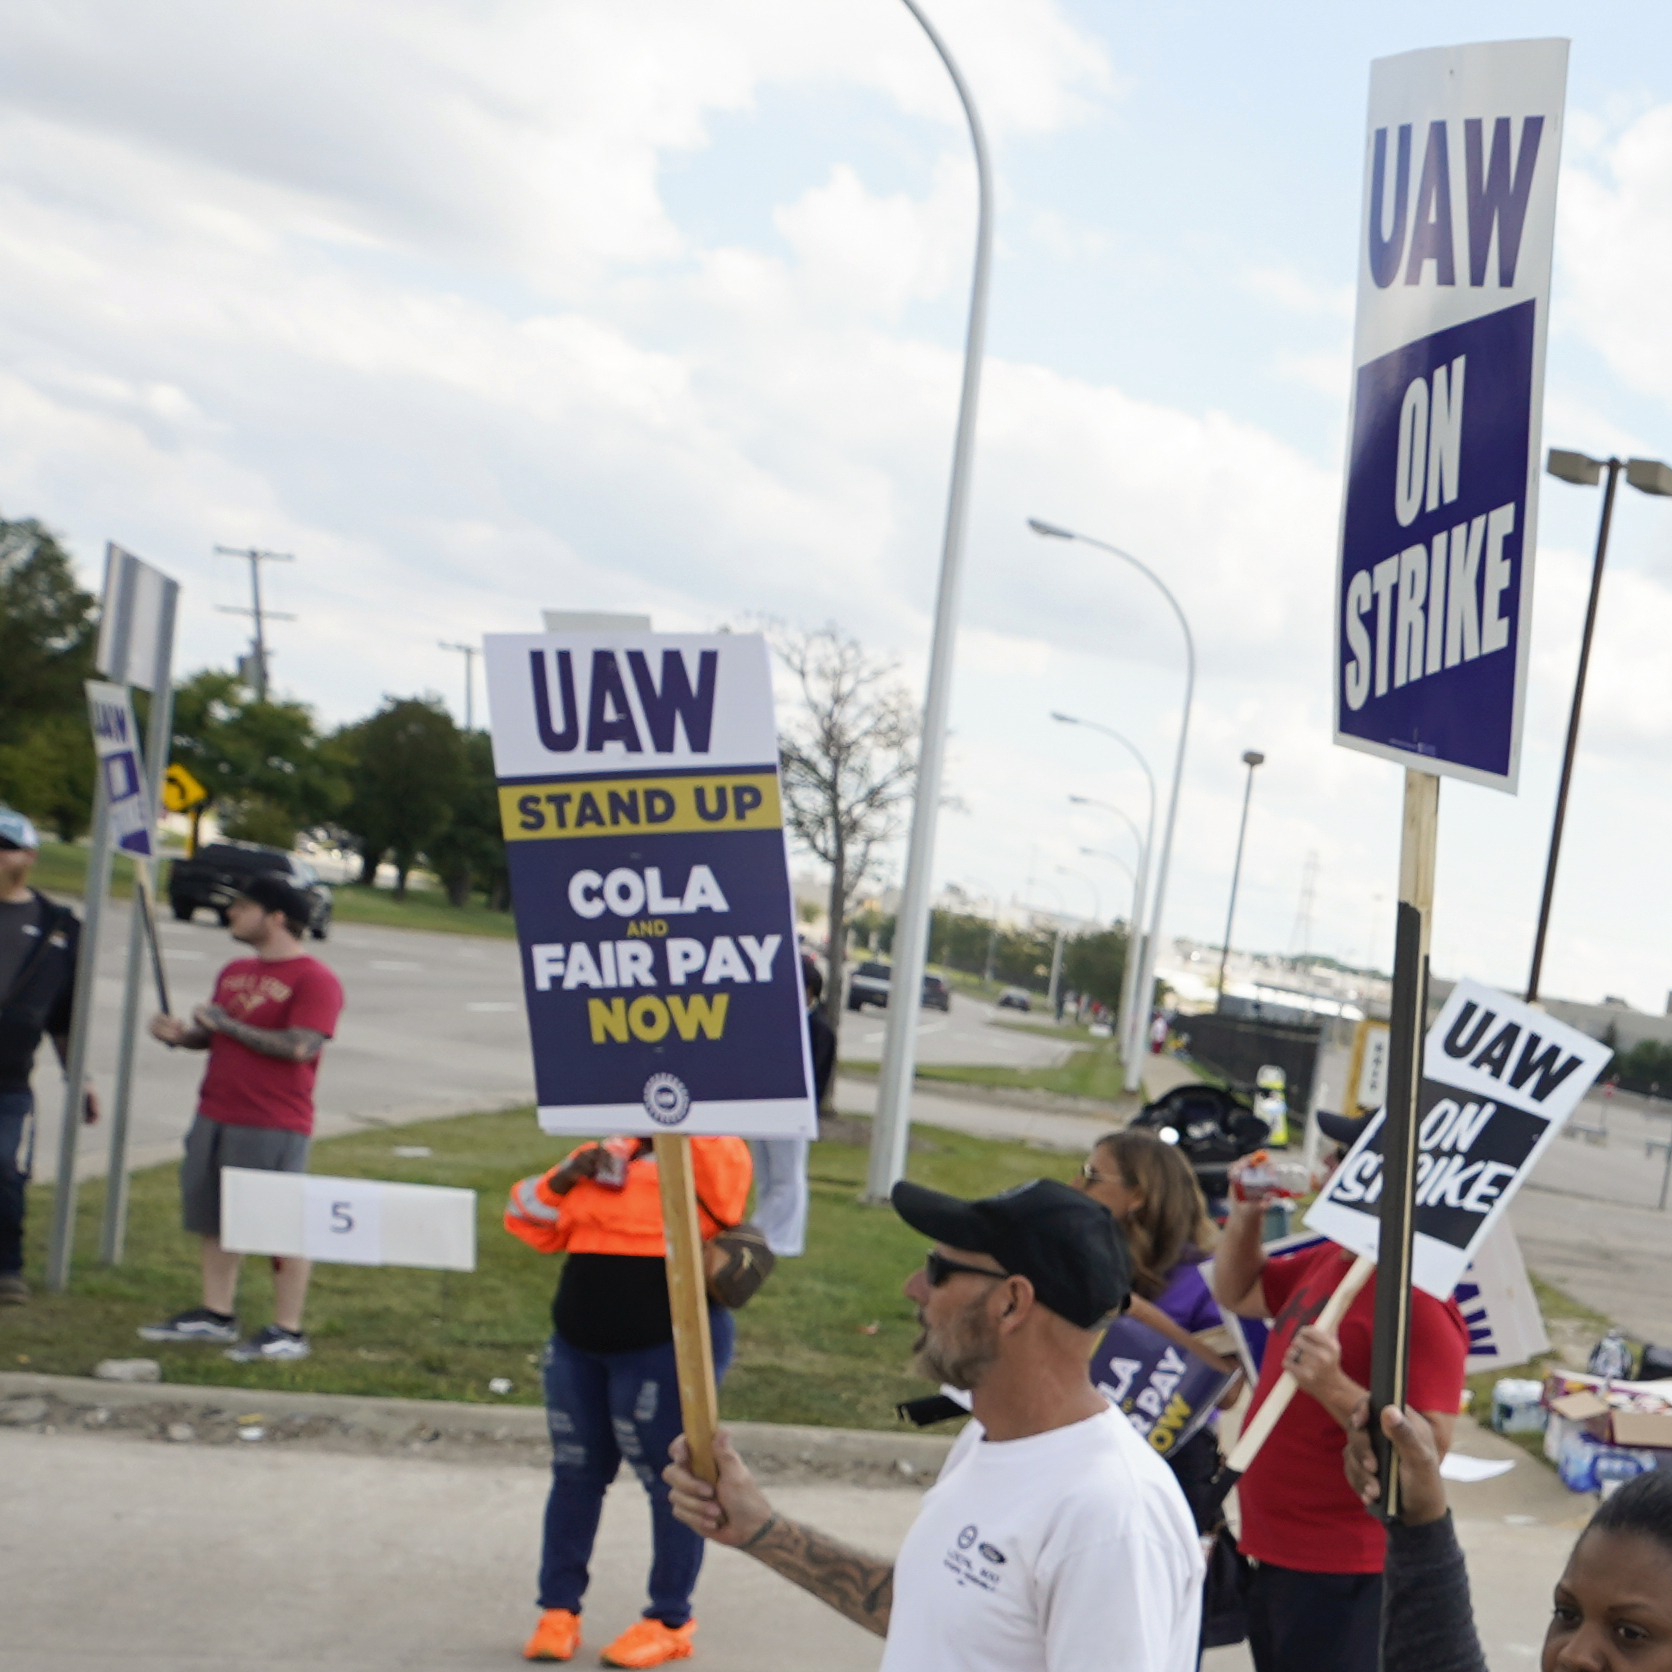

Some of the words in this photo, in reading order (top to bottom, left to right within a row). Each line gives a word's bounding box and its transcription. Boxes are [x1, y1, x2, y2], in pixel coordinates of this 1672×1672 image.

[1369, 115, 1545, 289] UAW
[1395, 354, 1466, 528] ON
[1345, 502, 1515, 712] STRIKE
[530, 649, 718, 753] UAW
[517, 788, 676, 831] STAND
[694, 784, 762, 822] UP
[568, 864, 730, 919] COLA
[626, 919, 669, 938] AND
[531, 939, 657, 992] FAIR
[666, 934, 782, 986] PAY
[588, 993, 729, 1045] NOW
[1443, 1000, 1585, 1104] UAW
[1419, 1098, 1497, 1153] ON
[331, 1201, 353, 1234] 5
[1136, 1345, 1187, 1418] PAY
[1147, 1391, 1192, 1453] OW
